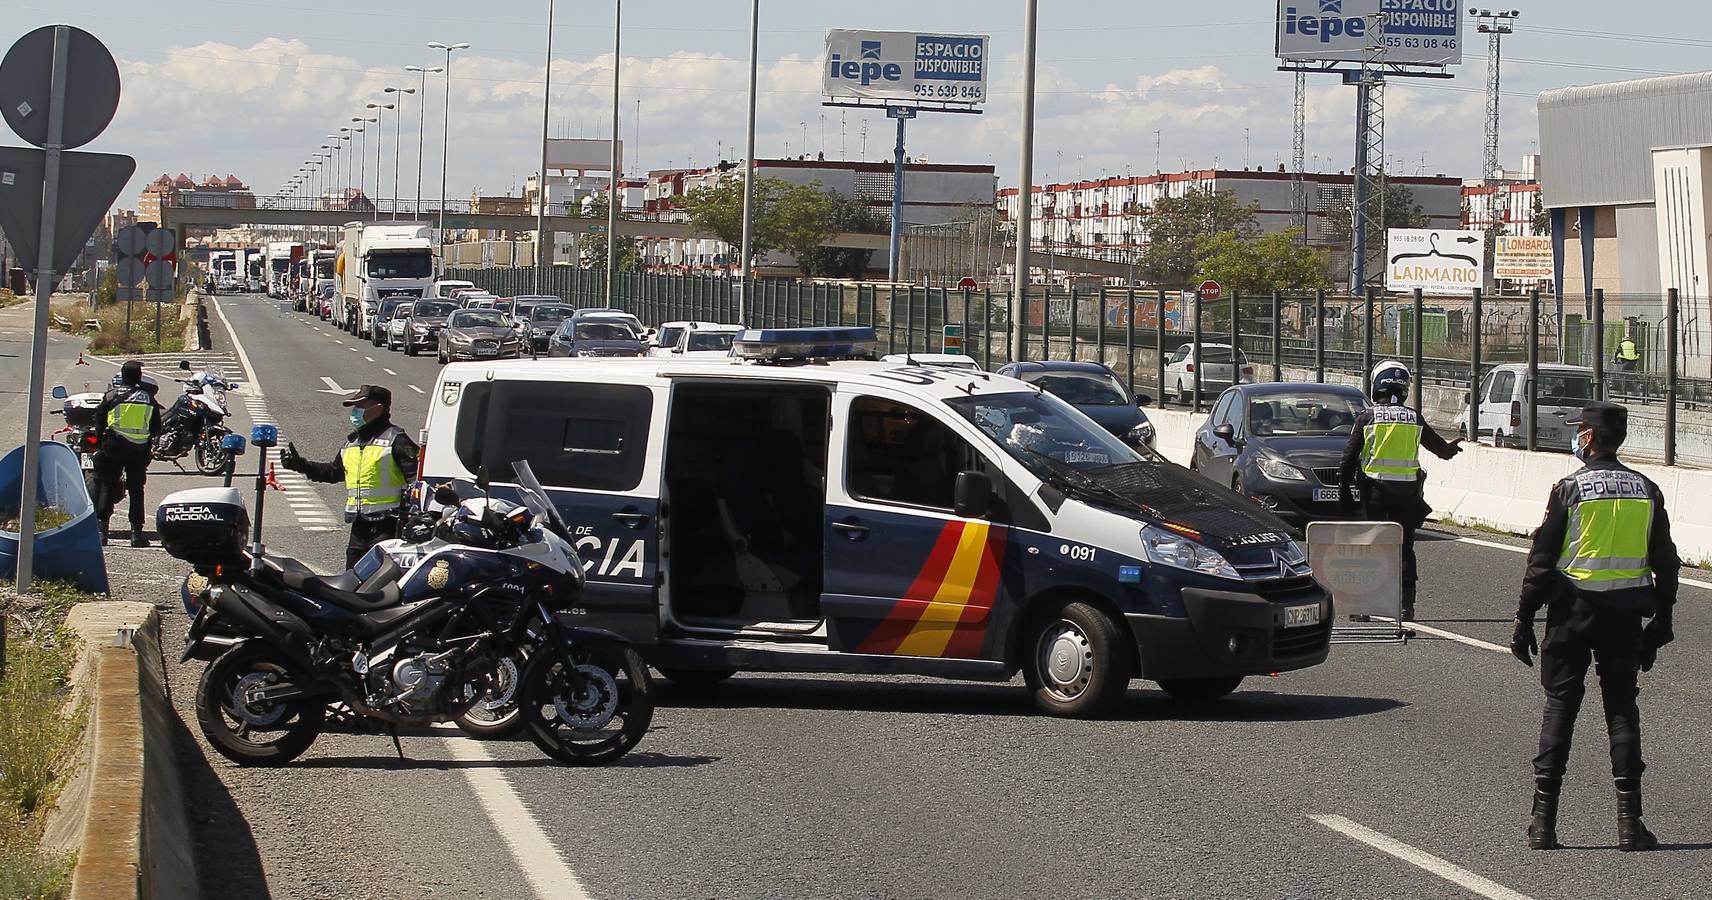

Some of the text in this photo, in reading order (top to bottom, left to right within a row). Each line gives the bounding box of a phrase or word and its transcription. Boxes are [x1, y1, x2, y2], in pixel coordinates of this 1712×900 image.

[1381, 0, 1457, 12] ESPACIO
[1286, 7, 1365, 43] iepe
[1380, 11, 1456, 28] DISPONIBLE
[916, 42, 982, 58] ESPACIO
[1405, 37, 1419, 48] 63
[1424, 38, 1438, 49] 08
[1442, 39, 1457, 49] 46
[830, 54, 901, 86] iepe
[915, 59, 980, 74] DISPONIBLE
[913, 84, 981, 98] 955 630 846
[1393, 266, 1477, 283] LARMARIO
[1581, 480, 1646, 497] POLICIA
[165, 513, 224, 521] NACIONAL
[575, 526, 593, 535] DE
[1070, 545, 1096, 561] 091
